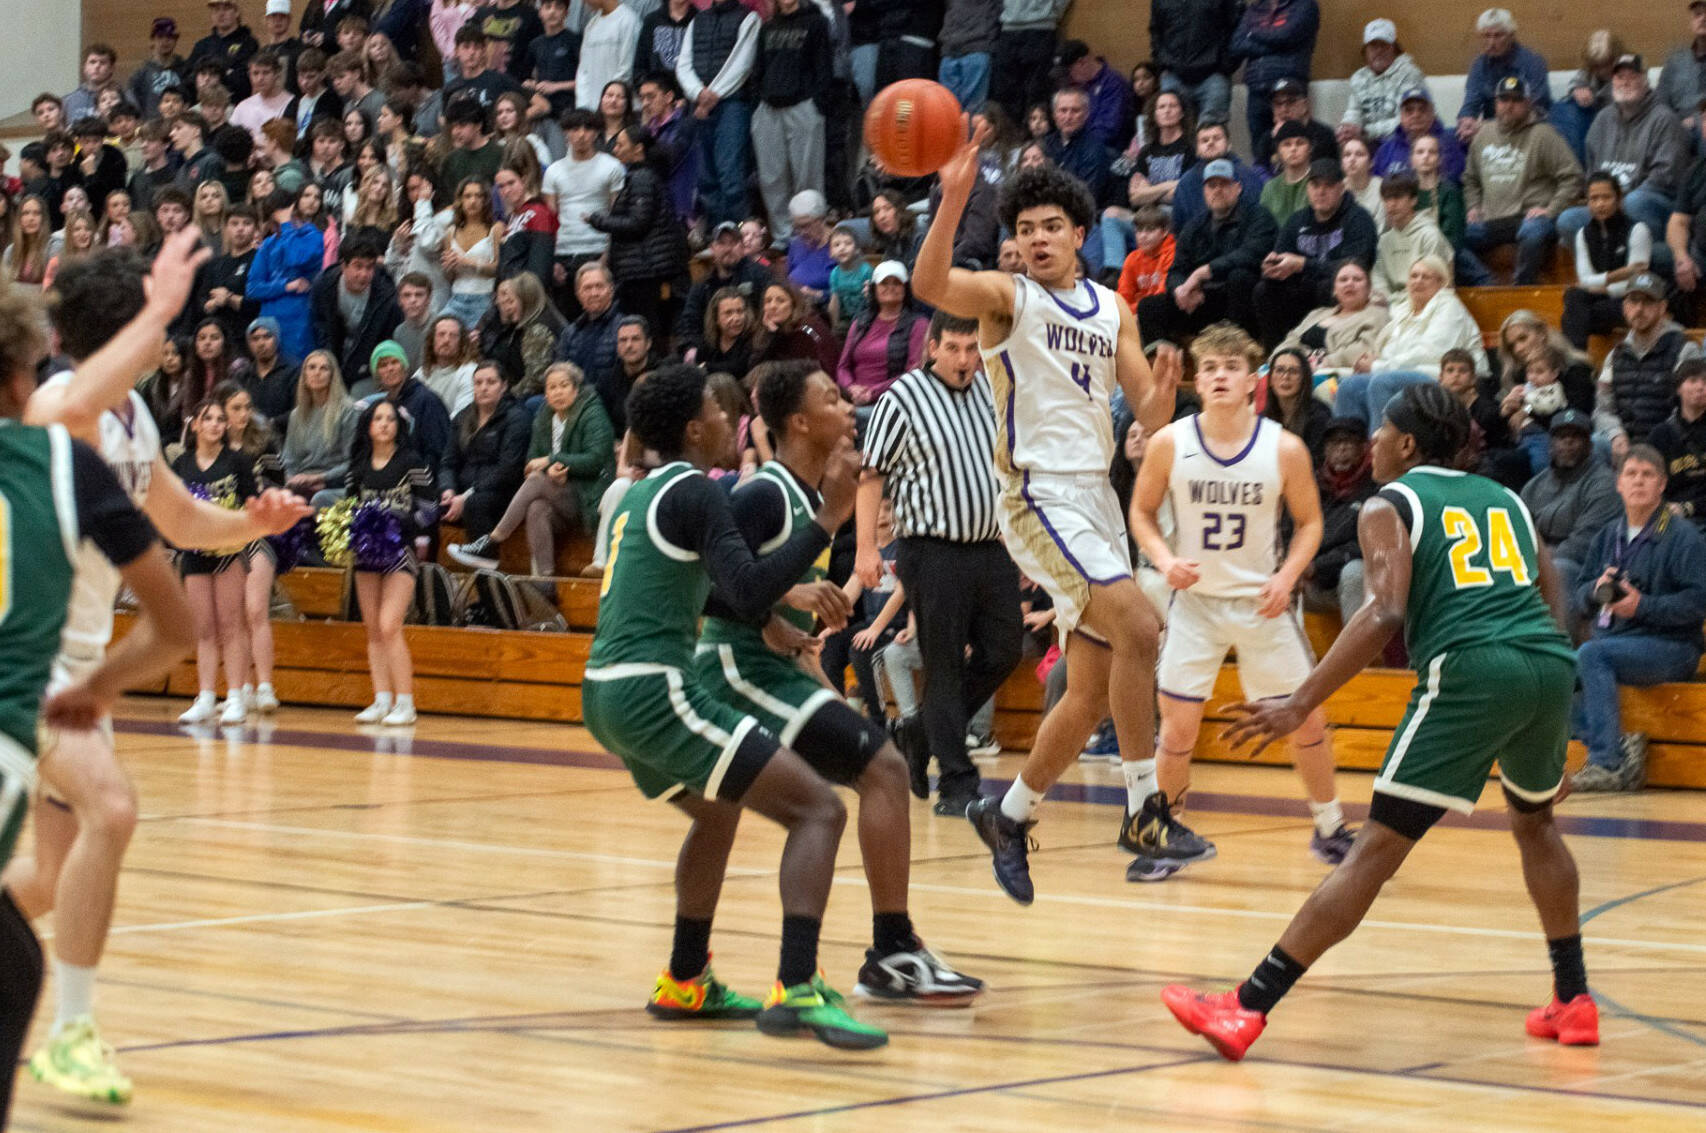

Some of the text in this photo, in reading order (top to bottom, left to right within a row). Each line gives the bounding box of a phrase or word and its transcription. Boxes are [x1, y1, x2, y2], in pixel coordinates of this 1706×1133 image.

[1046, 323, 1113, 358] WOLVES
[1070, 362, 1092, 401] 4
[1188, 480, 1264, 506] WOLVES
[1202, 512, 1246, 551] 23
[1441, 506, 1532, 590] 24
